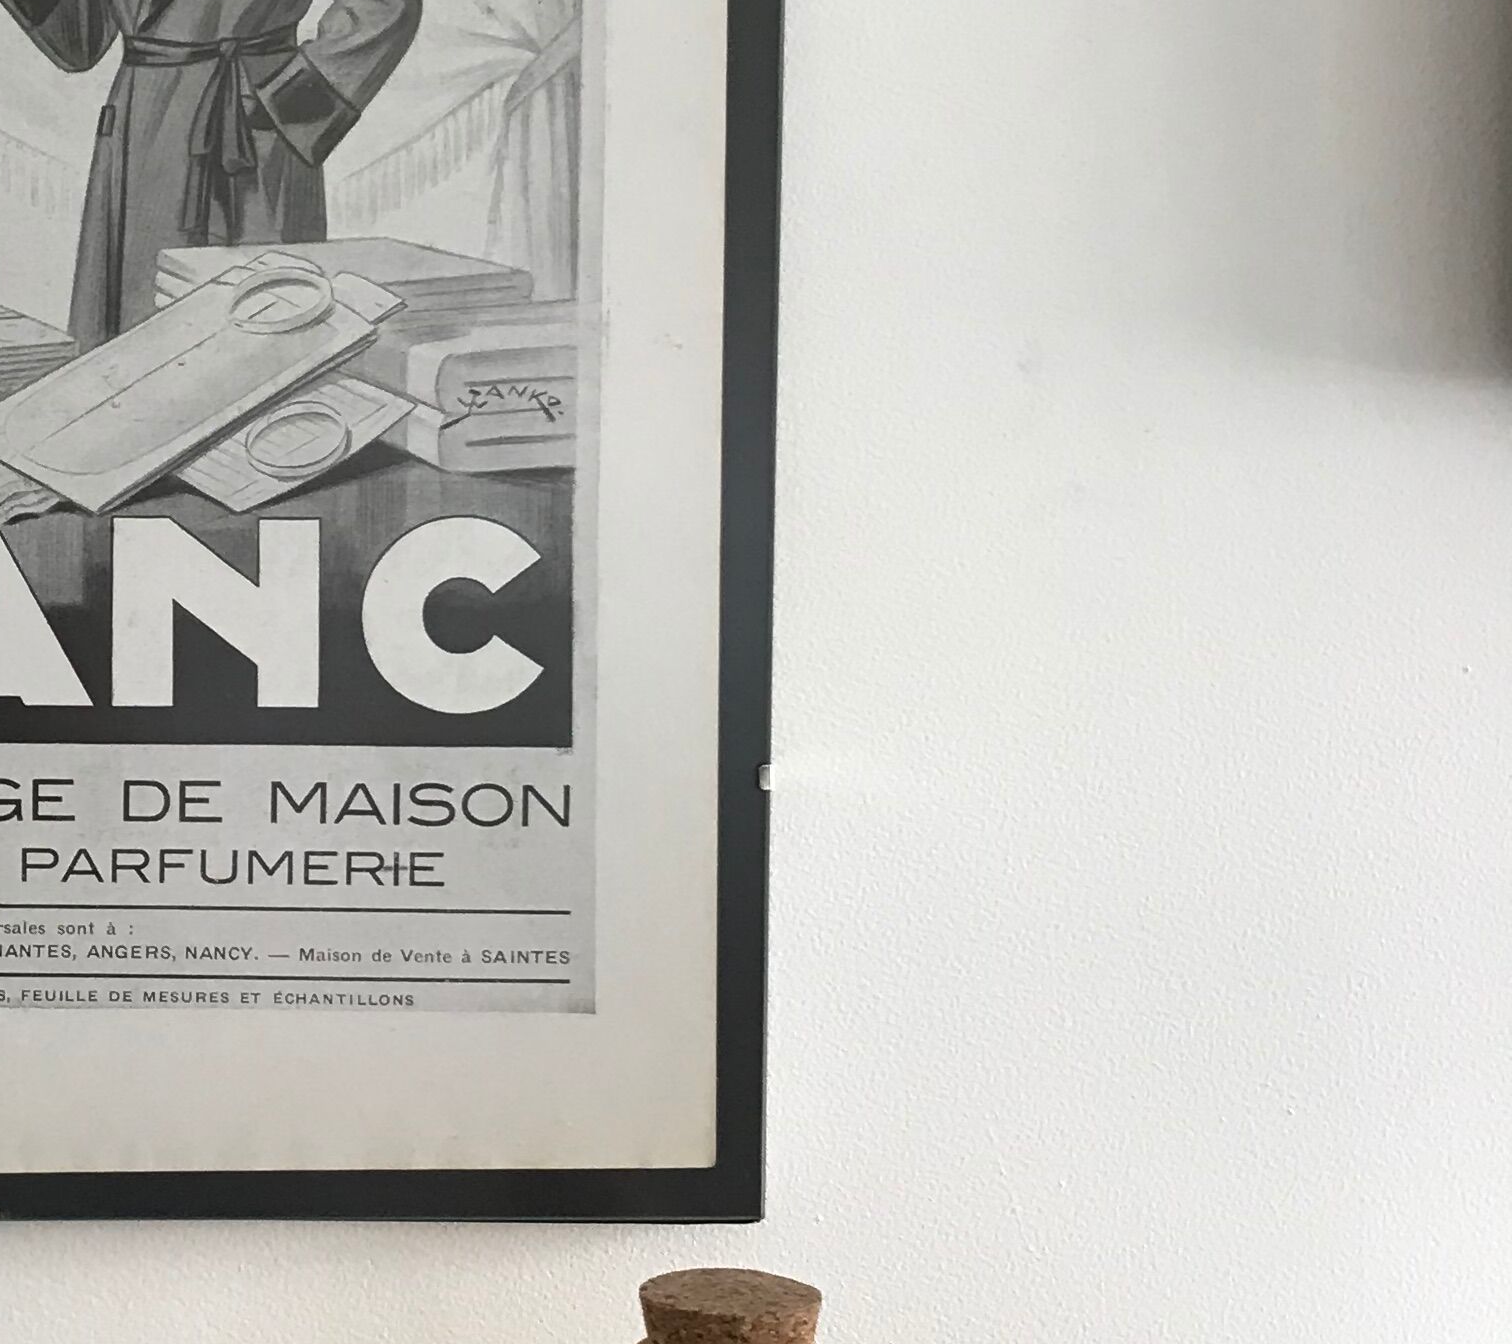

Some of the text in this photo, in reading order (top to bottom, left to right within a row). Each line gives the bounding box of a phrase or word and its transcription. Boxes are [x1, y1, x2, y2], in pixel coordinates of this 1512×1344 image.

[123, 780, 222, 823] DE
[271, 780, 570, 827] MAISON
[21, 848, 445, 887] PARFUMERIE
[57, 922, 94, 936] sont
[106, 922, 116, 935] à
[87, 945, 176, 962] ANGERS,
[186, 946, 258, 961] NANCY.
[299, 948, 361, 962] Maison
[372, 949, 392, 963] de
[400, 949, 452, 963] Vente
[461, 949, 472, 963] à
[482, 950, 570, 965] SAINTES
[20, 989, 99, 1004] FEUILLE
[108, 990, 133, 1004] DE
[143, 991, 230, 1005] MESURES
[241, 992, 261, 1004] ET
[273, 990, 415, 1008] ÉCHANTILLONS
